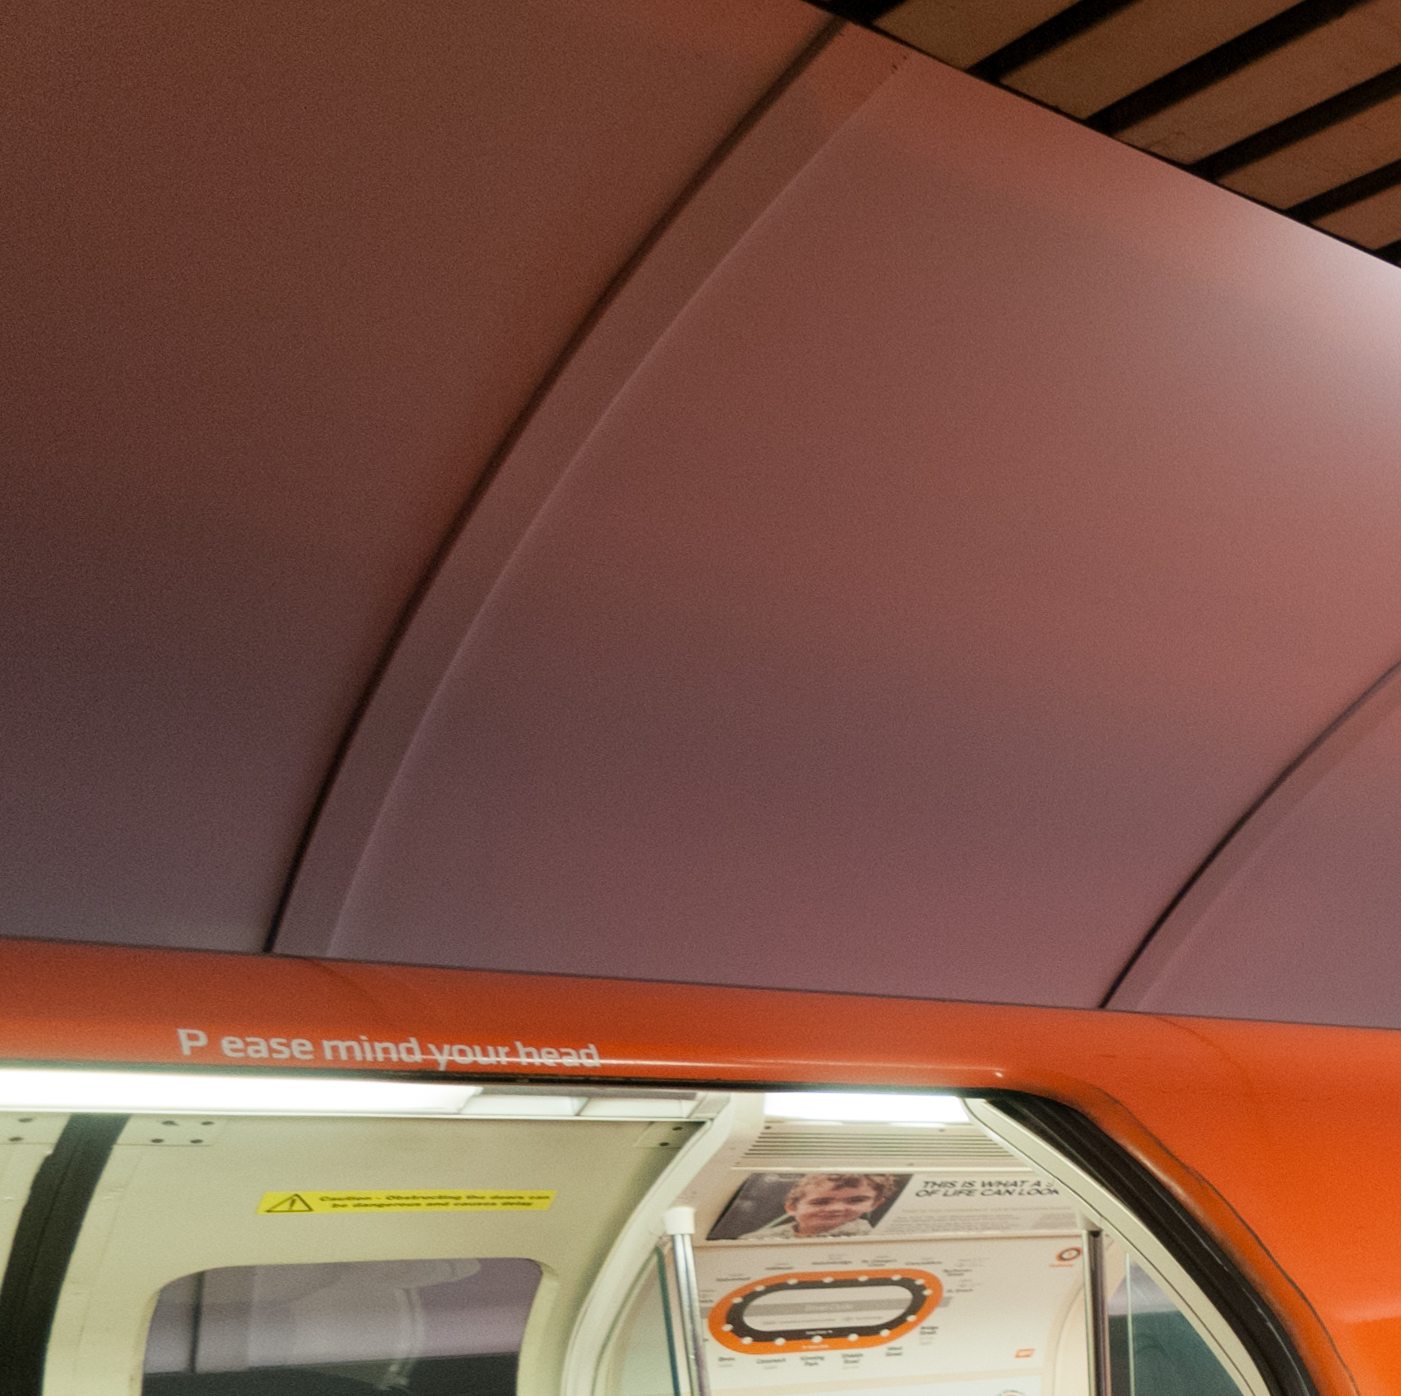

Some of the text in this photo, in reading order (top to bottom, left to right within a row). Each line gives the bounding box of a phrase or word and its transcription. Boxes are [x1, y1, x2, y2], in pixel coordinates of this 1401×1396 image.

[322, 1035, 422, 1063] mind
[428, 1042, 509, 1071] your
[513, 1041, 600, 1068] head
[923, 1180, 958, 1189] THIS
[961, 1180, 977, 1188] IS
[981, 1180, 1029, 1188] WHAT
[915, 1189, 941, 1198] OF
[942, 1189, 979, 1197] LIFE
[980, 1188, 1016, 1196] CAN
